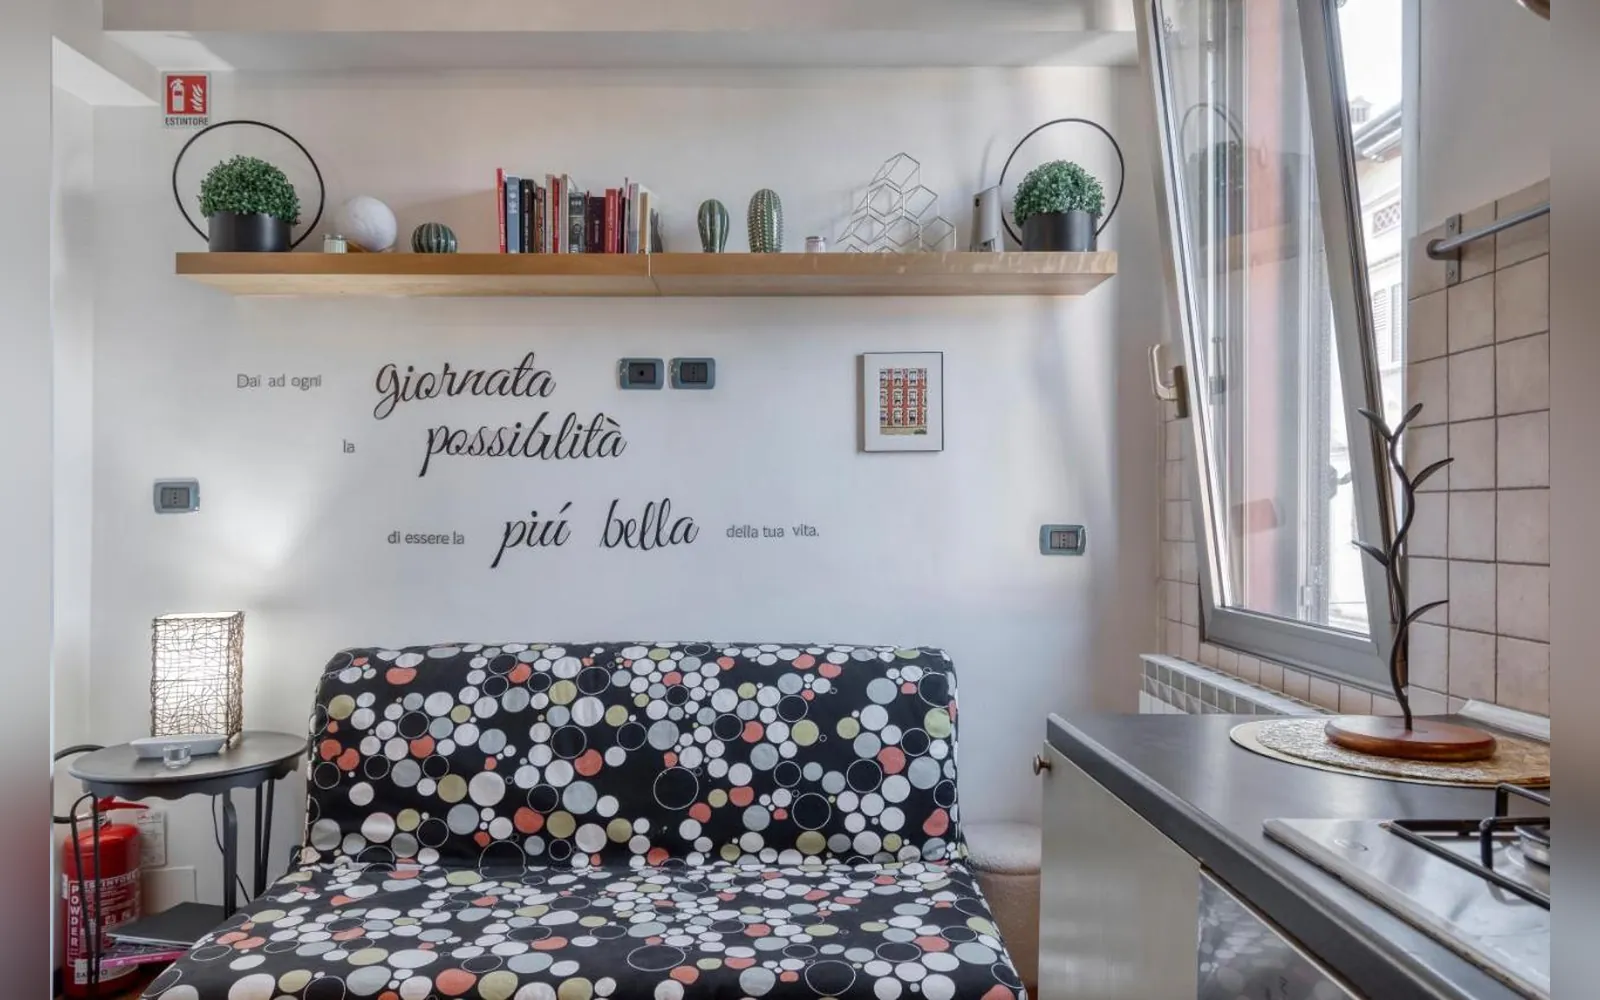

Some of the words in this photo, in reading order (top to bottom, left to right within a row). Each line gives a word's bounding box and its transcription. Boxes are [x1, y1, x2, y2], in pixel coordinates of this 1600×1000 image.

[165, 116, 209, 126] ESTINTORE
[236, 373, 261, 389] Dai
[267, 373, 286, 388] ad
[290, 374, 322, 392] ogni
[373, 351, 557, 420] giornata
[342, 438, 356, 454] la
[386, 530, 401, 545] di
[404, 532, 450, 545] essere
[452, 530, 465, 545] la
[598, 497, 701, 552] bella
[725, 523, 760, 539] della
[762, 525, 785, 539] tua
[791, 523, 820, 538] vita.
[70, 884, 80, 946] POWDER
